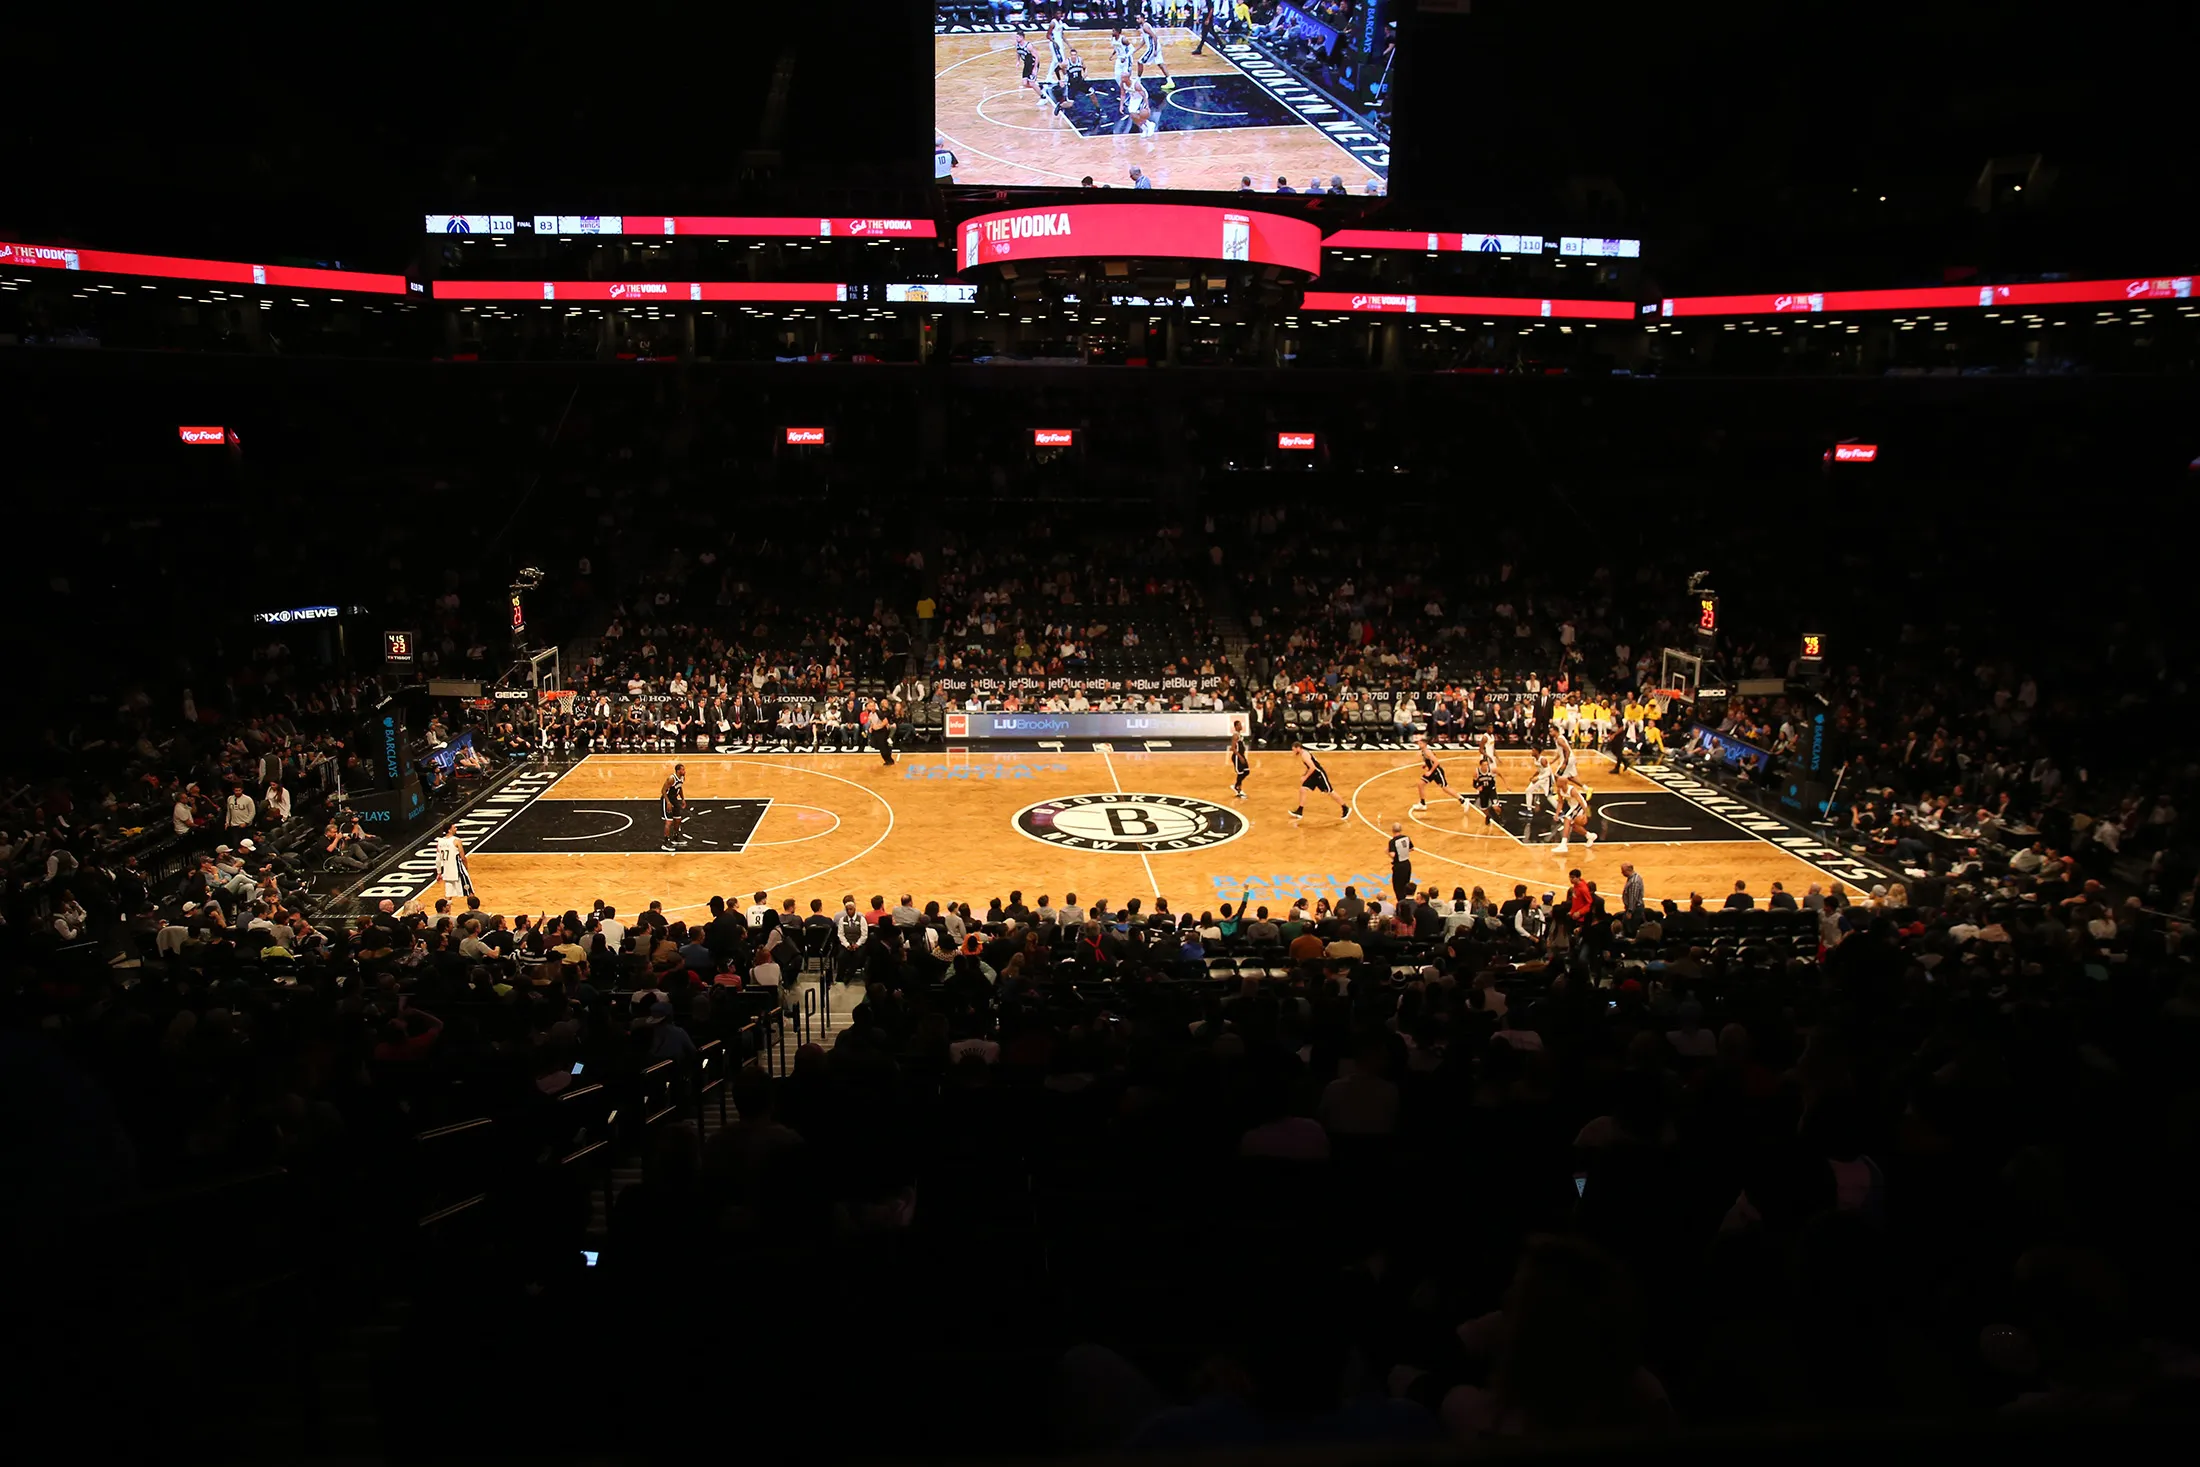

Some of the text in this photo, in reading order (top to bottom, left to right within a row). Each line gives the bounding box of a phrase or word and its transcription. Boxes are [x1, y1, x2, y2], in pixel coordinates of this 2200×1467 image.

[1223, 44, 1390, 167] BROOKLYN NETS
[938, 156, 946, 165] 10
[493, 221, 512, 231] 110
[539, 221, 553, 231] 83
[1523, 240, 1541, 250] 110
[1565, 242, 1577, 251] 83
[863, 293, 869, 301] 2
[294, 607, 338, 620] NEWS
[1701, 610, 1715, 628] 23
[392, 643, 406, 653] 23
[933, 678, 967, 691] eBlue
[1008, 677, 1038, 691] jeBlu
[1086, 678, 1121, 690] jetBue
[1162, 677, 1198, 691] jetBlue
[1201, 677, 1236, 691] jetBe
[495, 691, 528, 699] GEICO
[1396, 691, 1420, 700] 80
[385, 729, 398, 778] BARCLAYS
[486, 771, 558, 803] NETS
[1031, 794, 1221, 815] BROOKLYN
[1105, 807, 1160, 836] B
[1633, 765, 1887, 881] BROOKLYN NETS
[1041, 830, 1230, 851] NEW YORK
[755, 915, 761, 925] 8
